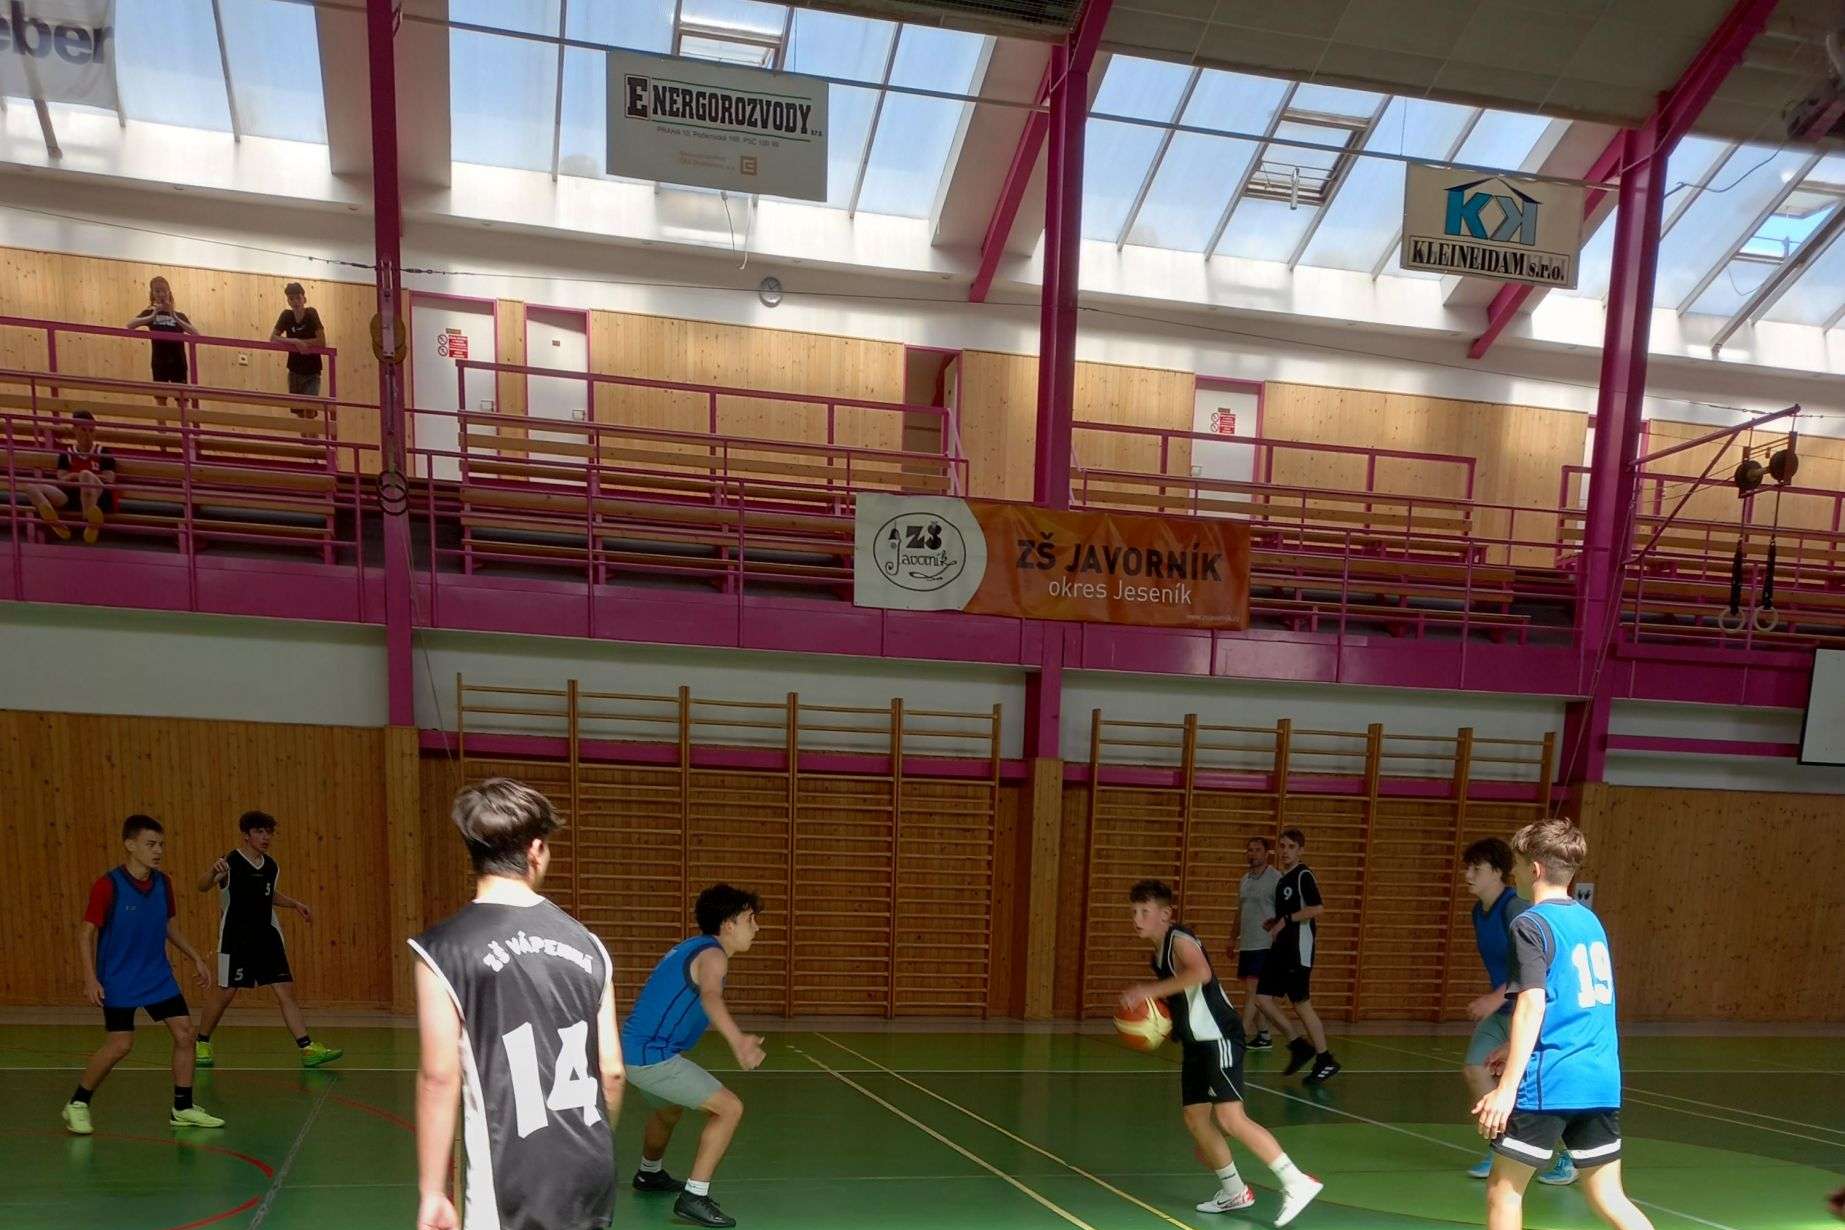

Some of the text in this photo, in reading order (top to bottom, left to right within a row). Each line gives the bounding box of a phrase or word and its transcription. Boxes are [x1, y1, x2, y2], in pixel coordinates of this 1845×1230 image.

[626, 76, 812, 135] ENERGOROZVODY
[1411, 240, 1565, 281] KLEINEIDAM s.r.o.
[906, 521, 942, 550] ZŠ
[1016, 532, 1222, 582] ZŠ JAVORNÍK
[1049, 576, 1192, 604] okres Jeseník
[1283, 886, 1293, 900] 9
[234, 967, 244, 981] 5
[483, 940, 510, 973] ZŠ
[1571, 941, 1614, 1009] 19
[502, 1020, 602, 1139] 14
